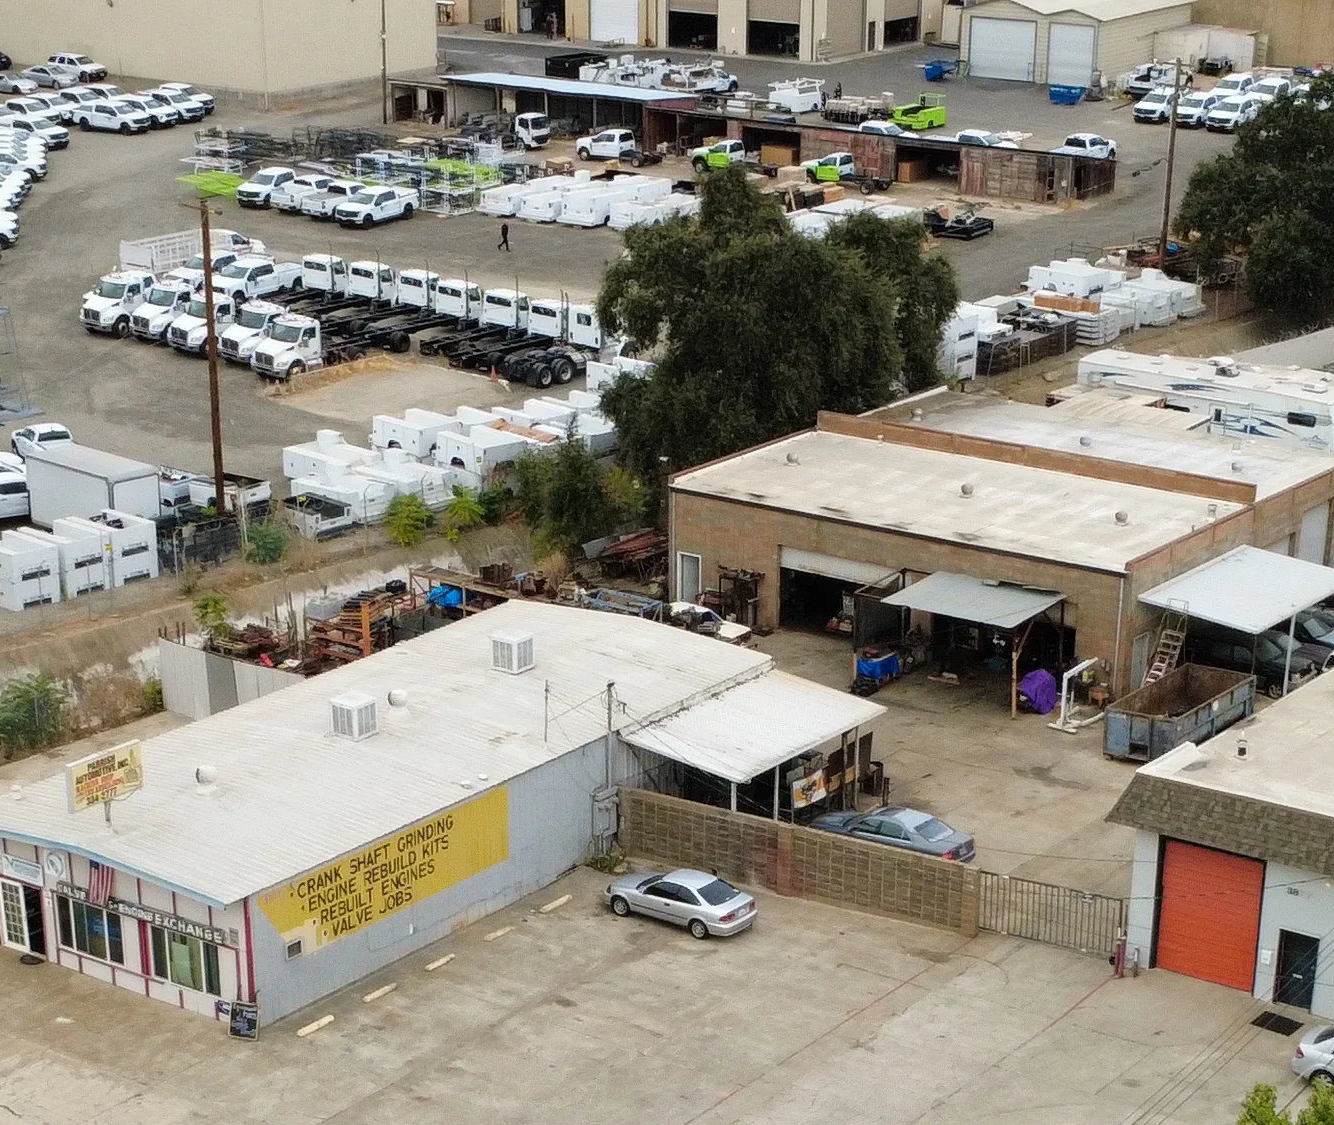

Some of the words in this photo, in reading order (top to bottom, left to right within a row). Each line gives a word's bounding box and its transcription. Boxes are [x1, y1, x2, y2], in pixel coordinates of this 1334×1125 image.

[297, 865, 342, 899] CRANK
[349, 843, 391, 875] SHAFT
[397, 815, 454, 852] GRINDING
[308, 881, 357, 913] ENGINE
[364, 852, 417, 885] REBUILD
[422, 834, 449, 857] KITS
[320, 888, 373, 925] REBUILT
[381, 859, 435, 896] ENGINES
[331, 909, 372, 937] VALVE
[379, 886, 413, 914] JOBS
[155, 913, 224, 944] EXCHANGE
